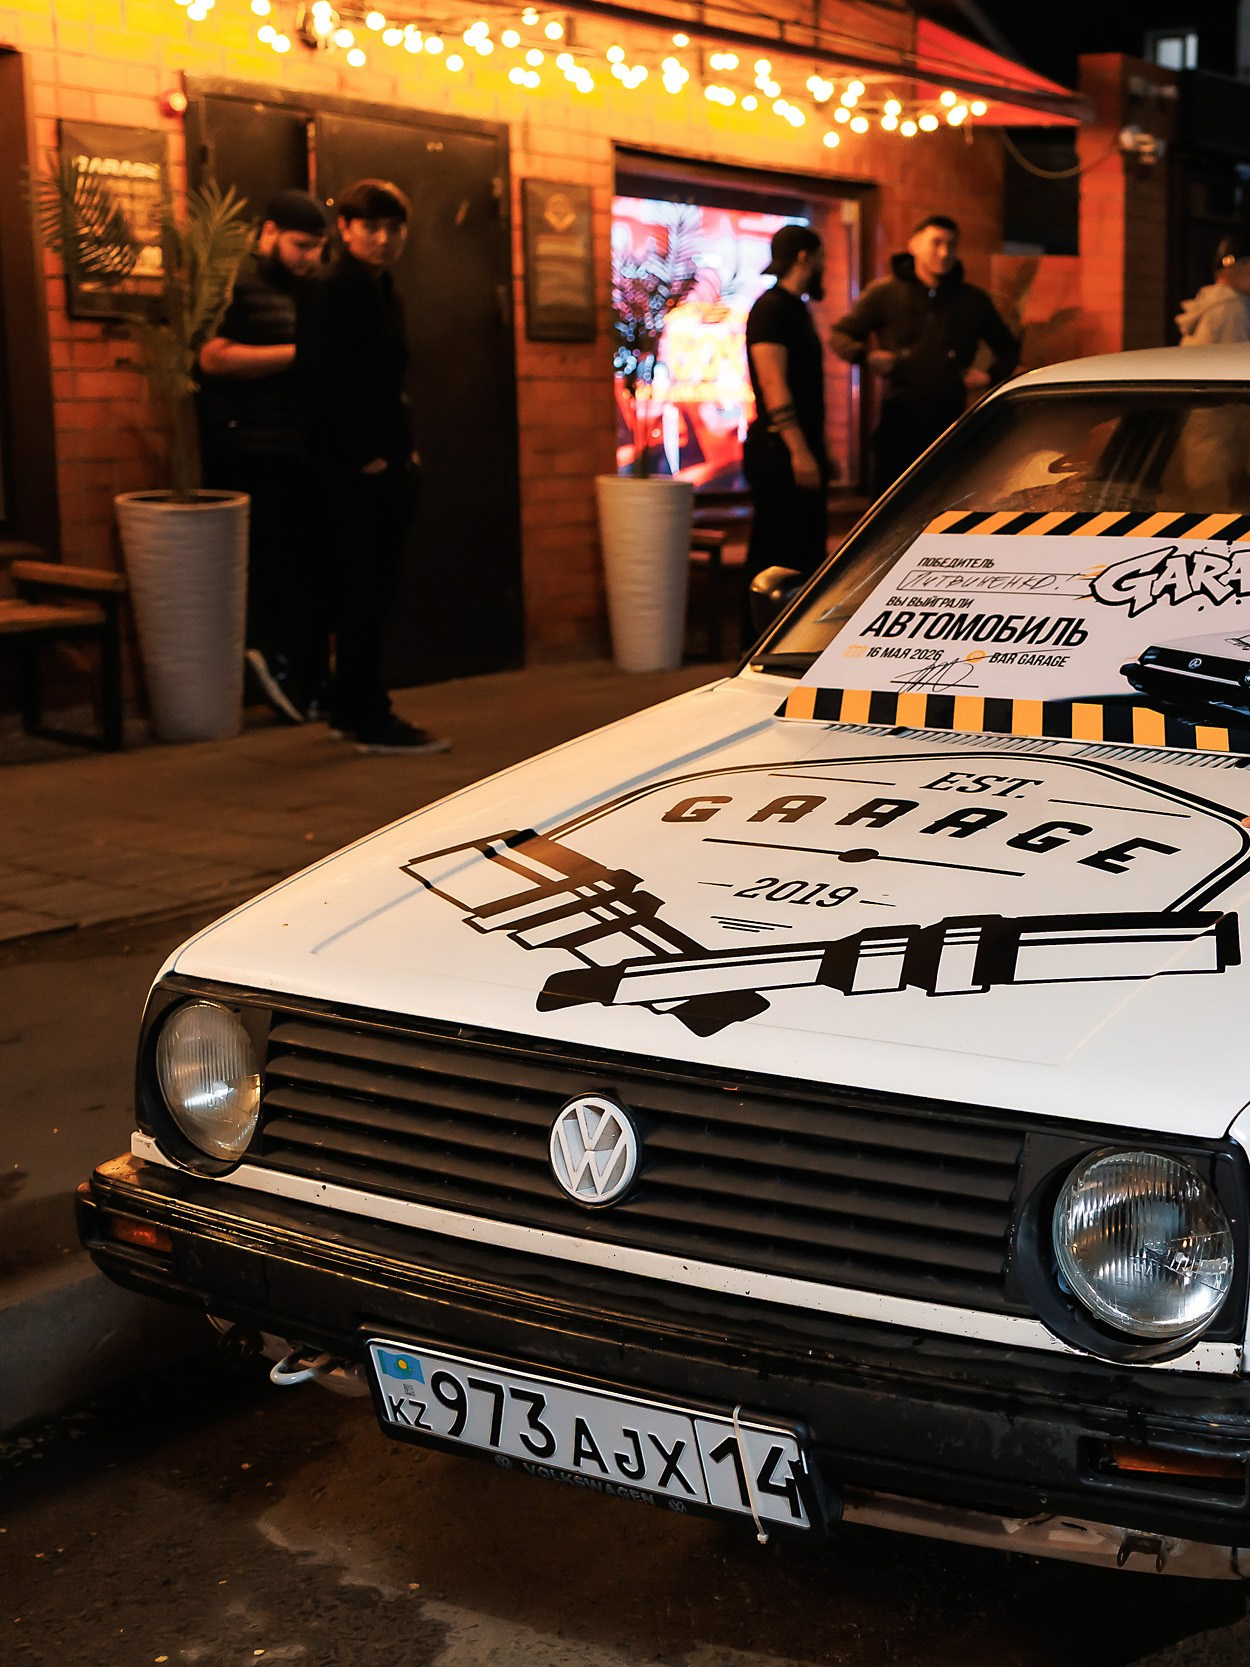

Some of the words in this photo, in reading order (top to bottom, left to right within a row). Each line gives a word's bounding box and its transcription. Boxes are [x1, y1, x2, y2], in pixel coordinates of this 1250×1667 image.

[916, 557, 995, 568] ПОБЕДИТЕЛЬ
[885, 596, 907, 607] ВЫ
[906, 595, 975, 609] ВЫЙГРАЛИ
[859, 610, 1088, 647] АВТОМОБИЛЬ
[866, 646, 881, 657] 16
[880, 647, 912, 659] МАЯ
[909, 648, 944, 661] 2026
[988, 652, 1018, 664] BAR
[1017, 654, 1070, 668] GARAGE
[918, 771, 1044, 799] EST.
[660, 794, 1183, 875] GARAGE
[733, 877, 860, 907] 2019
[388, 1394, 432, 1431] KZ
[431, 1369, 557, 1458] 973
[573, 1416, 697, 1495] AJX
[709, 1436, 803, 1519] 14
[522, 1461, 657, 1506] VOLKSWAGEN
